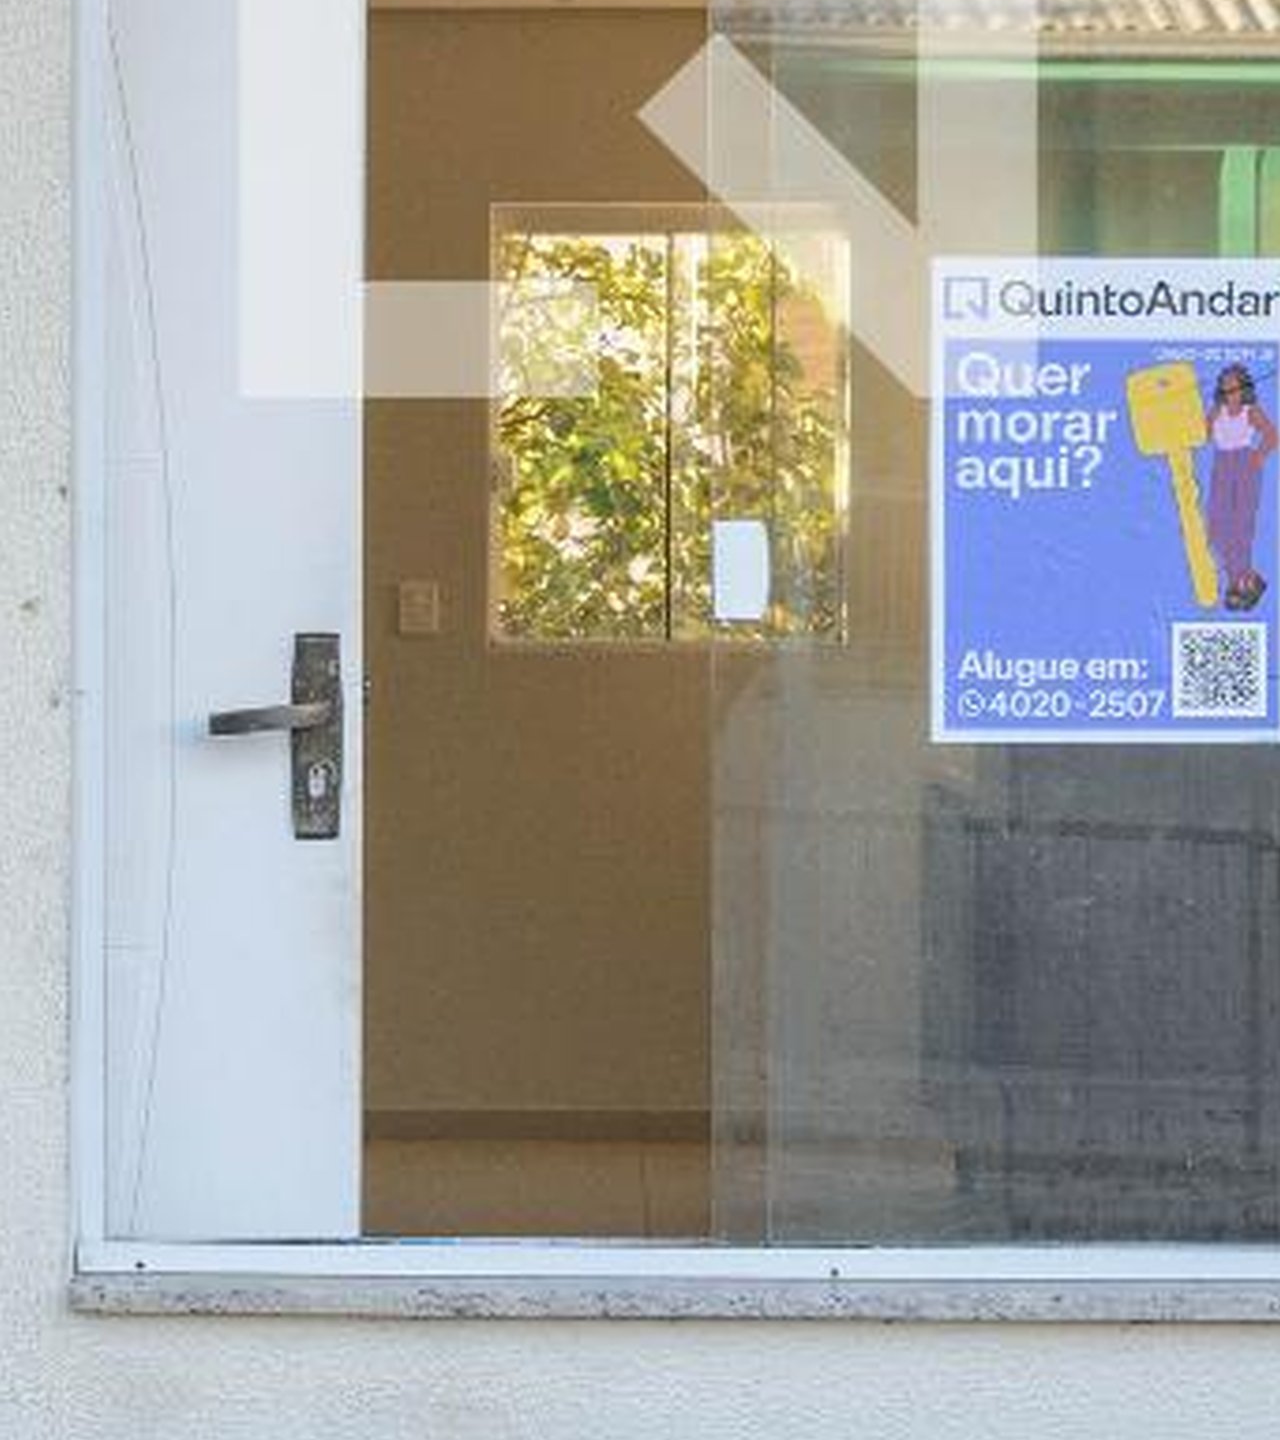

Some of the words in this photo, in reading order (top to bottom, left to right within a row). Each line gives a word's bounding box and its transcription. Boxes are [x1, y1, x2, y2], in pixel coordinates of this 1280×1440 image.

[999, 278, 1280, 320] QuintoAndar
[956, 352, 1091, 398] Quer
[956, 408, 1118, 444] morar
[956, 444, 1104, 499] aqui?
[958, 650, 1079, 688] Alugue
[1084, 656, 1149, 680] em:
